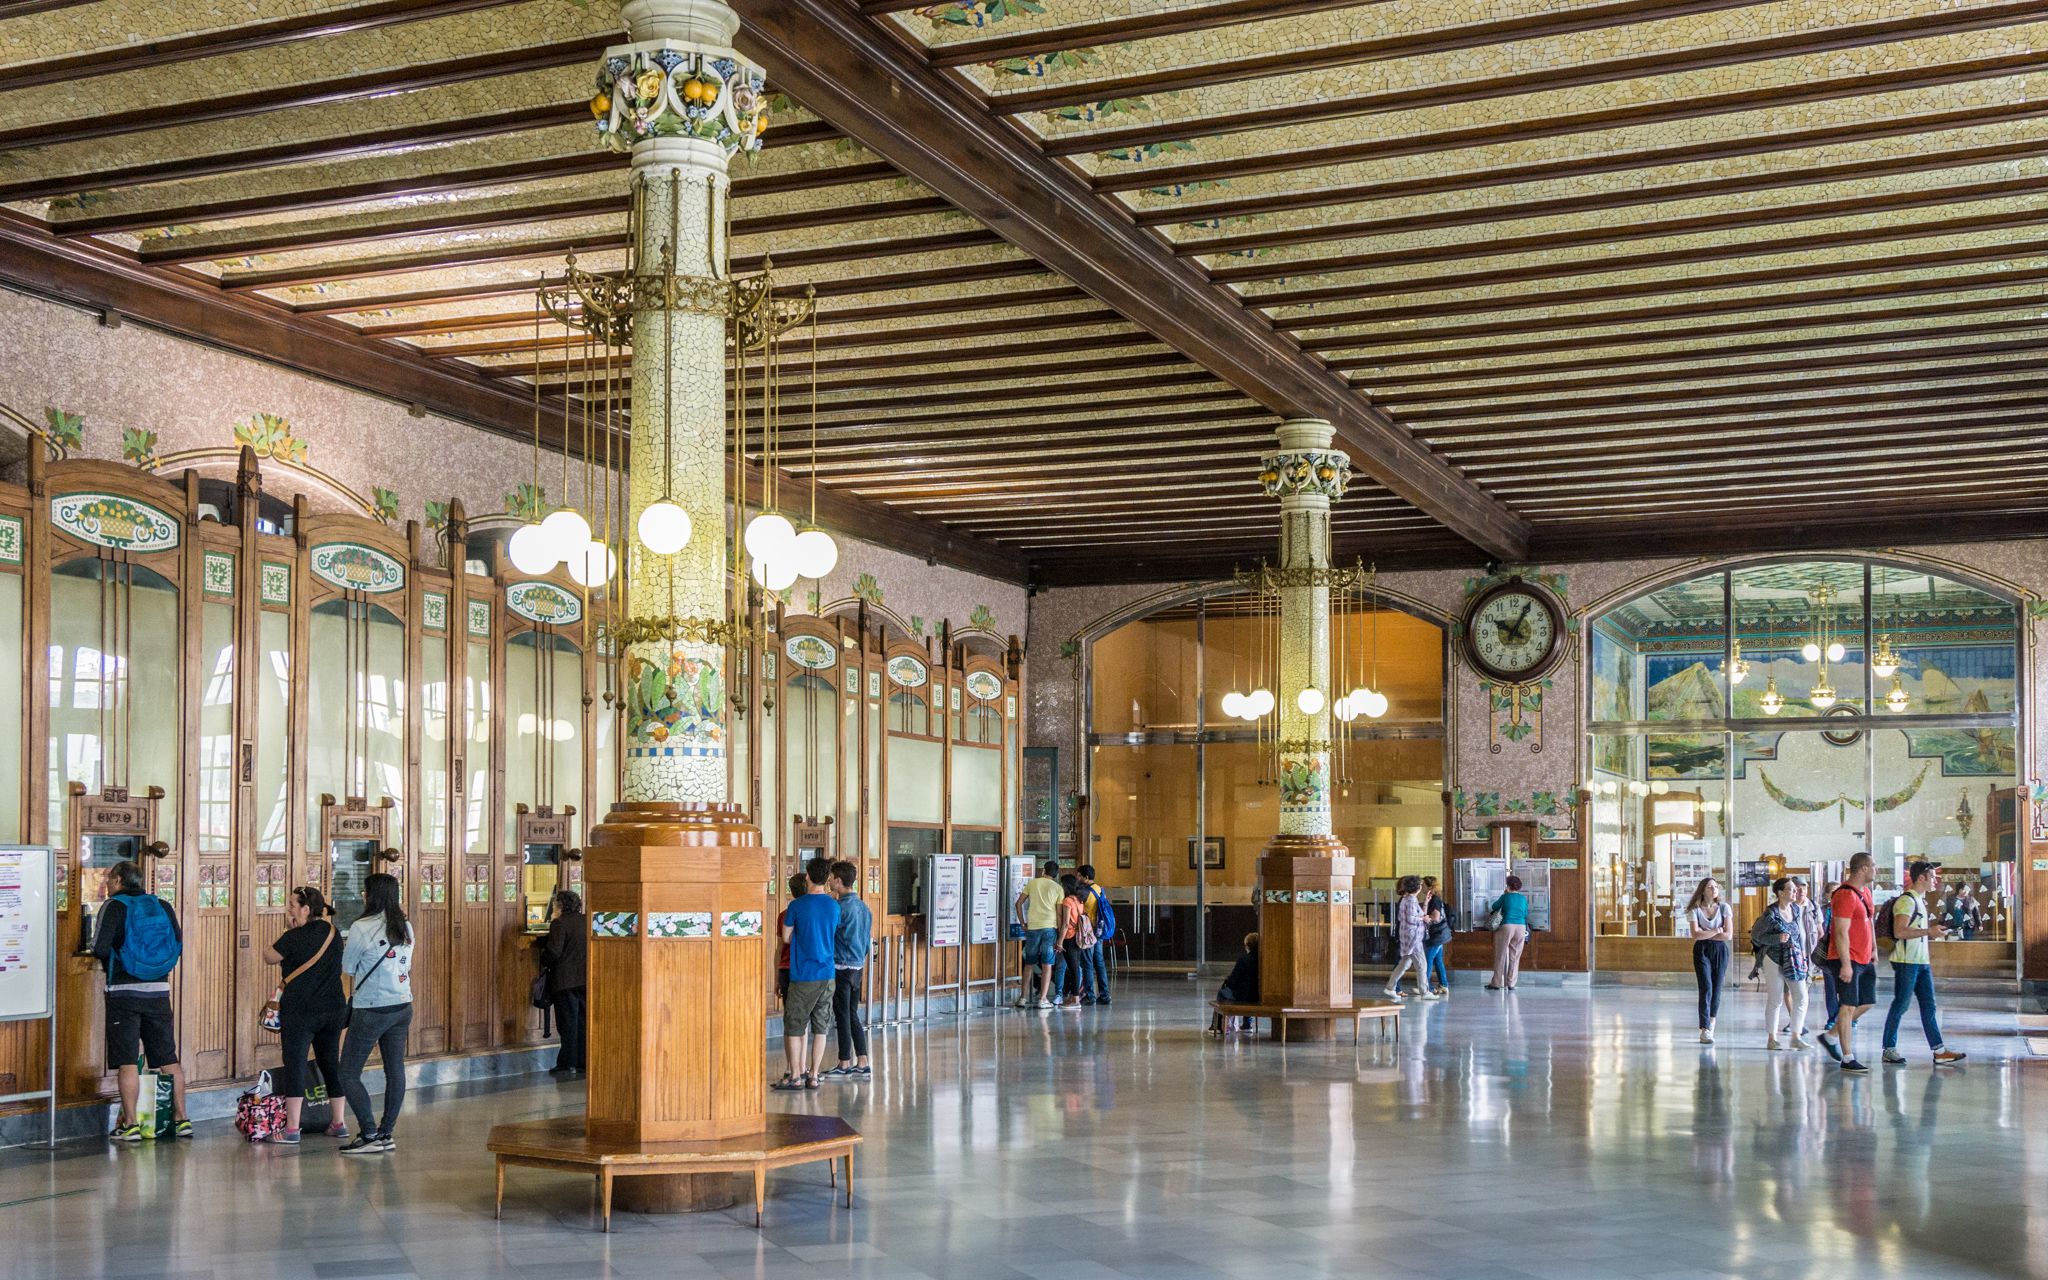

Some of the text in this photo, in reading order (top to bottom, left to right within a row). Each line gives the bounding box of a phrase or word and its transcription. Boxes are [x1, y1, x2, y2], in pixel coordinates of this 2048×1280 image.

[1496, 603, 1504, 612] 11
[1510, 598, 1519, 608] 12
[1485, 613, 1494, 623] 10
[1537, 611, 1544, 621] 2
[1482, 629, 1488, 638] 9
[1540, 627, 1546, 637] 3
[1485, 643, 1493, 653] 8
[1536, 642, 1543, 652] 4
[1496, 654, 1503, 664] 7
[1510, 657, 1517, 666] 6
[1525, 653, 1532, 663] 5
